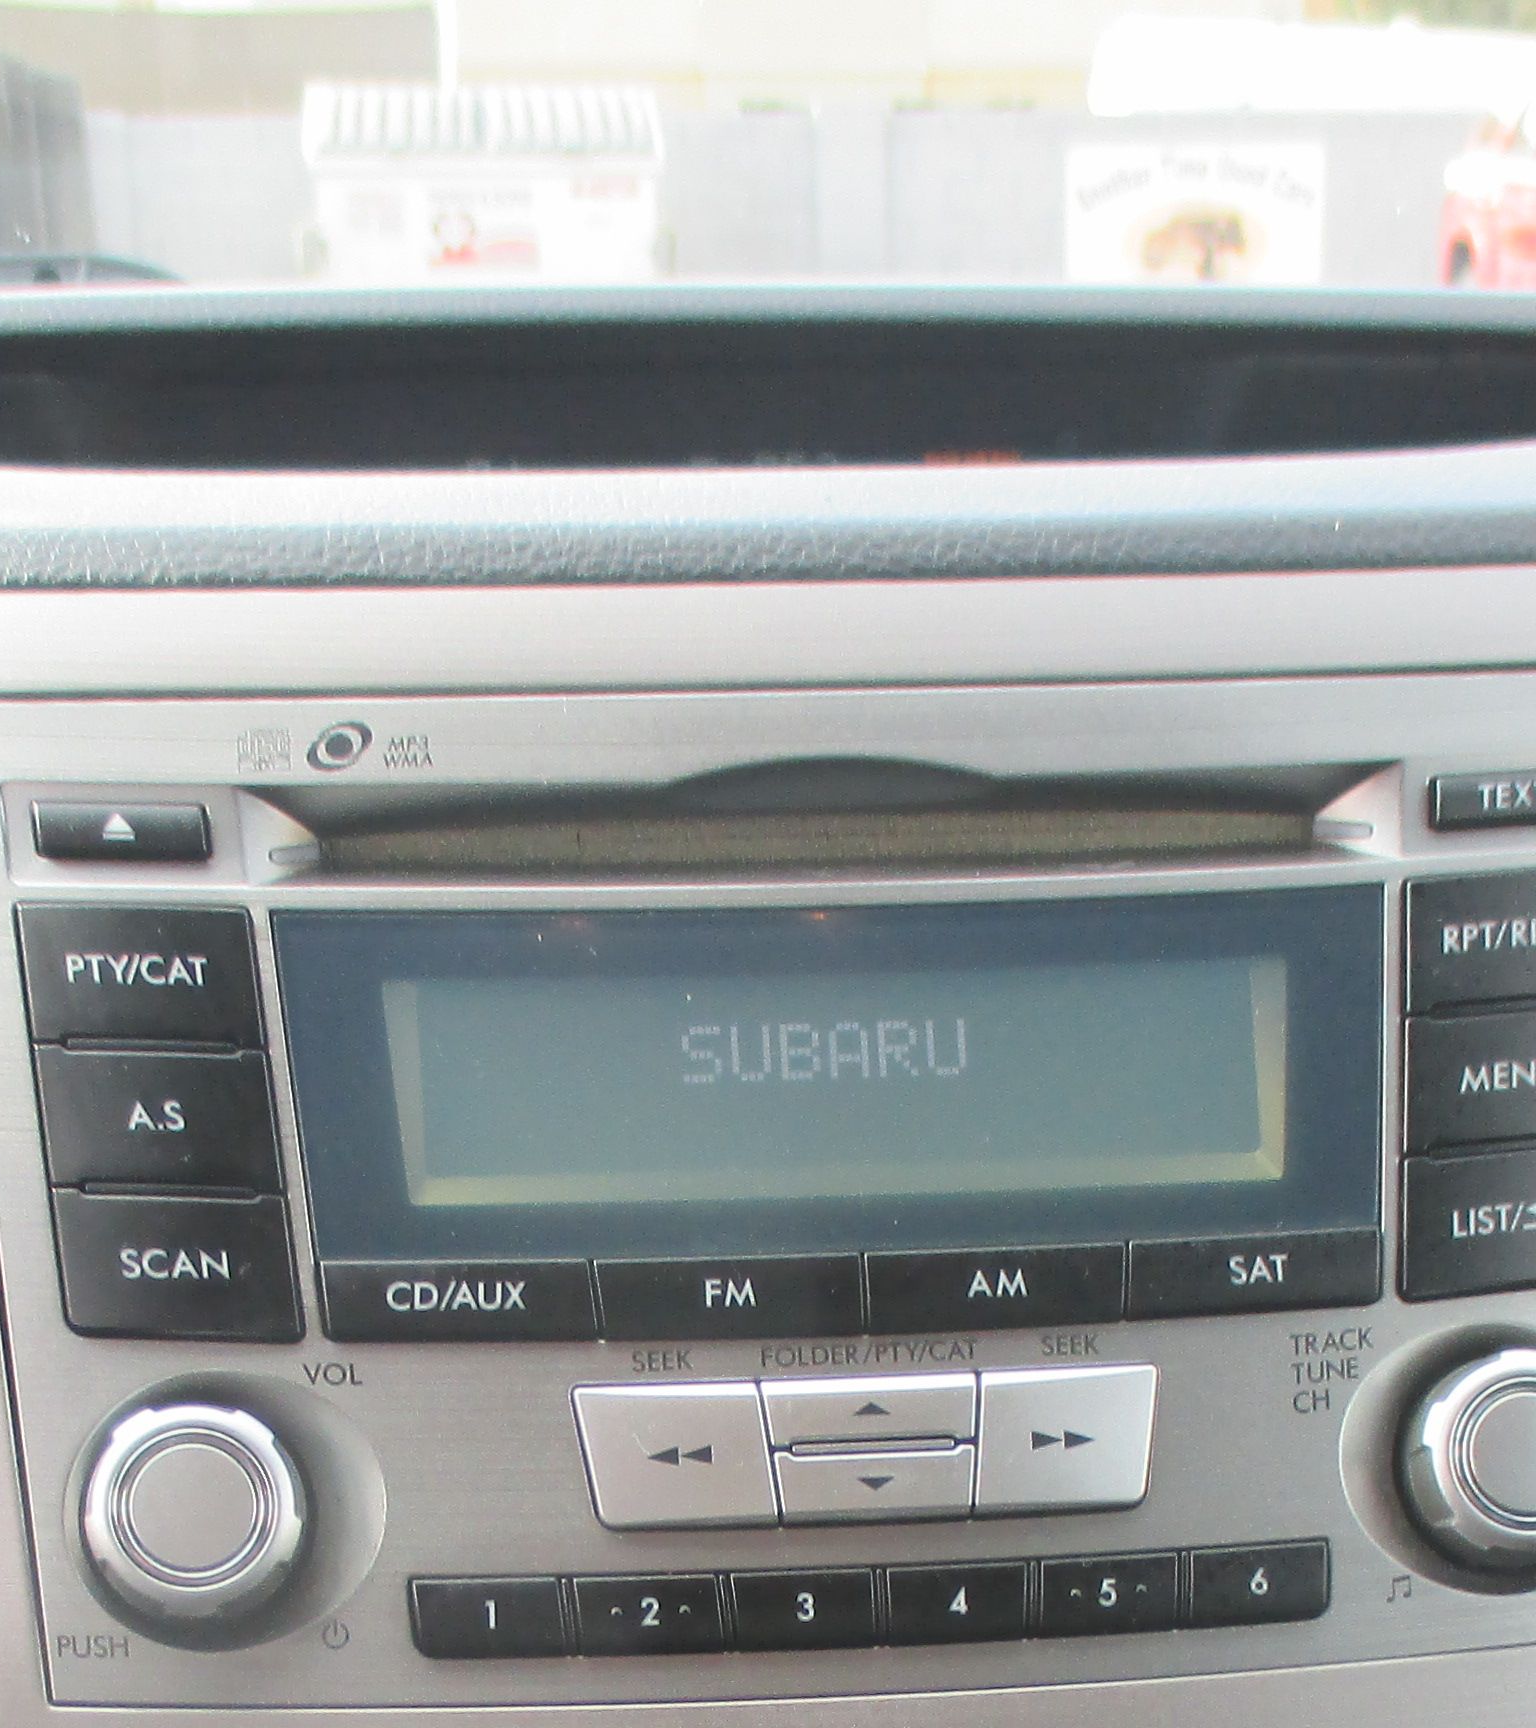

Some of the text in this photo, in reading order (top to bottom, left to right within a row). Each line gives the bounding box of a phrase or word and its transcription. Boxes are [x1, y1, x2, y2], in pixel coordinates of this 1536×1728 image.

[384, 752, 434, 768] WMA
[65, 953, 209, 986] PTY/CAT
[680, 1018, 967, 1084] SUBARU
[128, 1101, 186, 1131] A.S
[120, 1249, 231, 1280] SCAN
[1229, 1253, 1288, 1284] SAT
[385, 1281, 525, 1313] CD/AUX
[704, 1278, 757, 1308] FM
[967, 1269, 1028, 1299] AM
[760, 1338, 978, 1368] FOLDER/PTY/CAT
[1041, 1333, 1099, 1358] SEEK
[1290, 1326, 1373, 1356] TRACK
[303, 1362, 362, 1386] VOL
[631, 1349, 693, 1374] SEEK
[1291, 1357, 1359, 1384] TUNE
[1293, 1390, 1330, 1414] CH
[1250, 1567, 1268, 1594] 6
[484, 1601, 497, 1629] 1
[796, 1594, 815, 1621] 3
[949, 1586, 967, 1616] 4
[56, 1634, 130, 1660] PUSH
